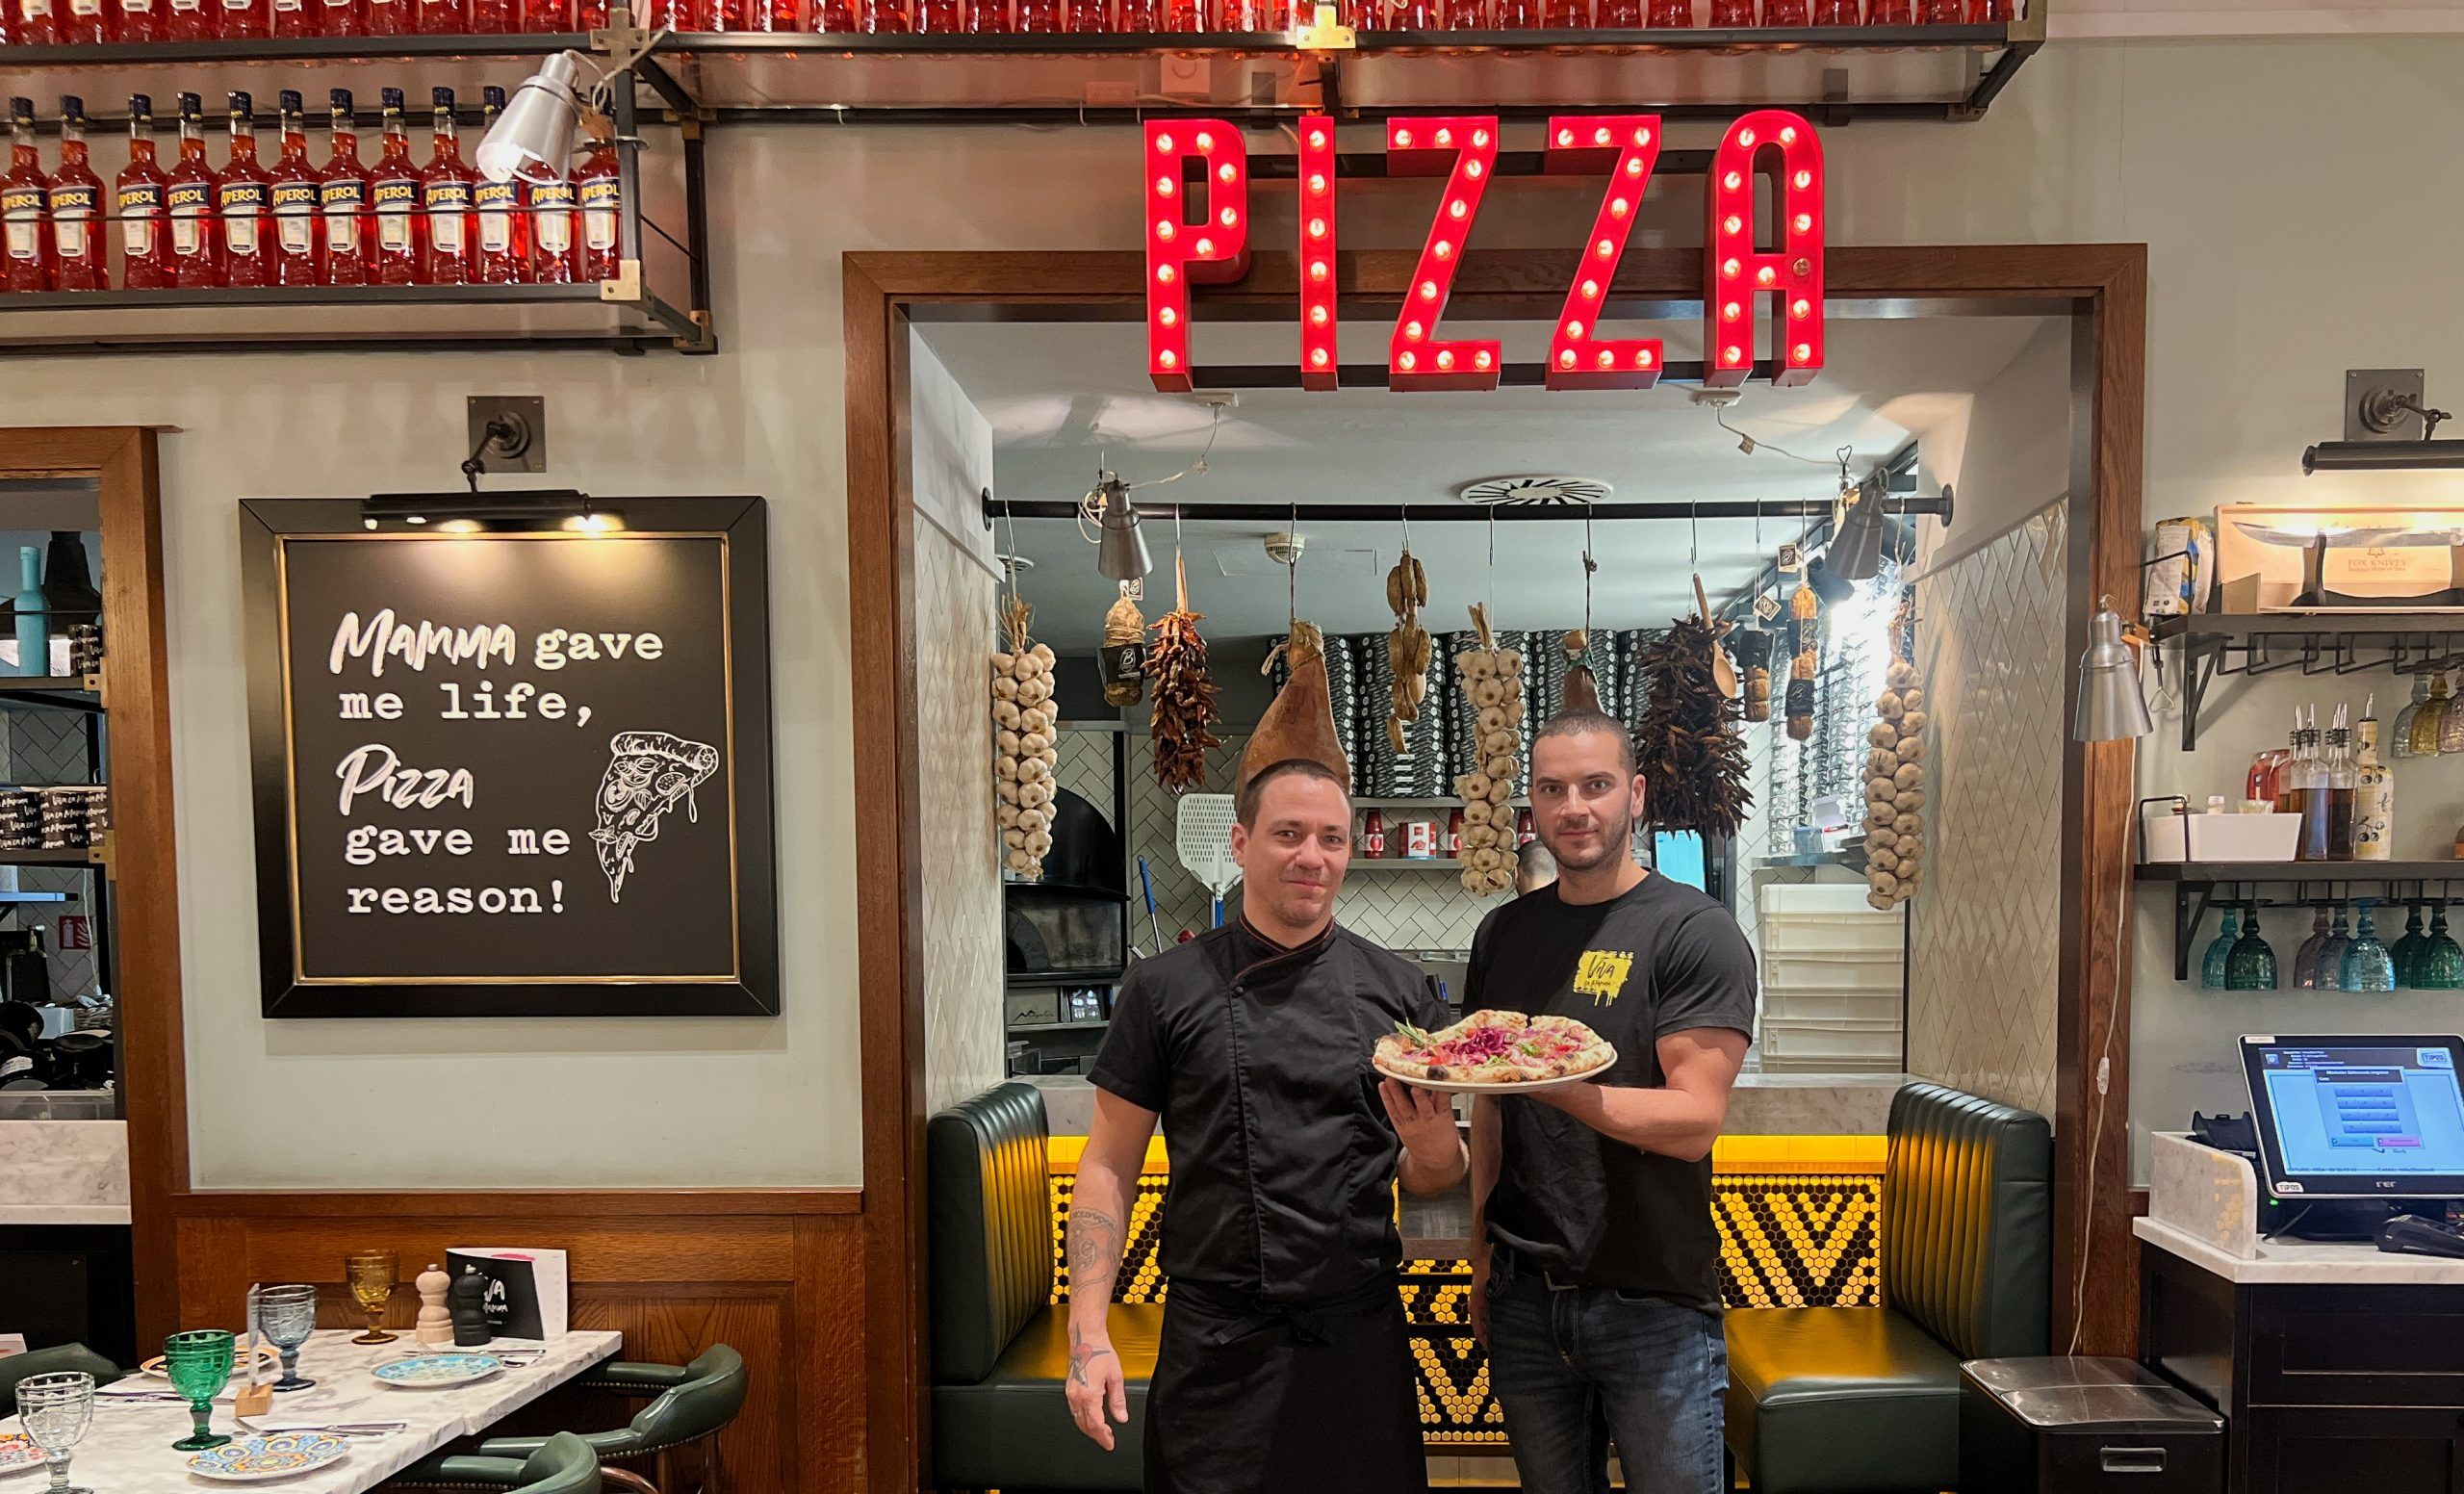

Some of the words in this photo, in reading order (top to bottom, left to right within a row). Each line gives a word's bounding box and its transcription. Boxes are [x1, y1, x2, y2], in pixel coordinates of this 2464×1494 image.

[220, 189, 262, 208] APEROL
[272, 189, 317, 206] APEROL
[425, 187, 469, 206] APEROL
[1144, 110, 1825, 389] PIZZA
[534, 629, 664, 670] gave
[339, 691, 404, 720] me
[440, 681, 592, 728] life,
[345, 826, 474, 865] gave
[507, 829, 571, 856] me
[347, 879, 565, 914] reason!
